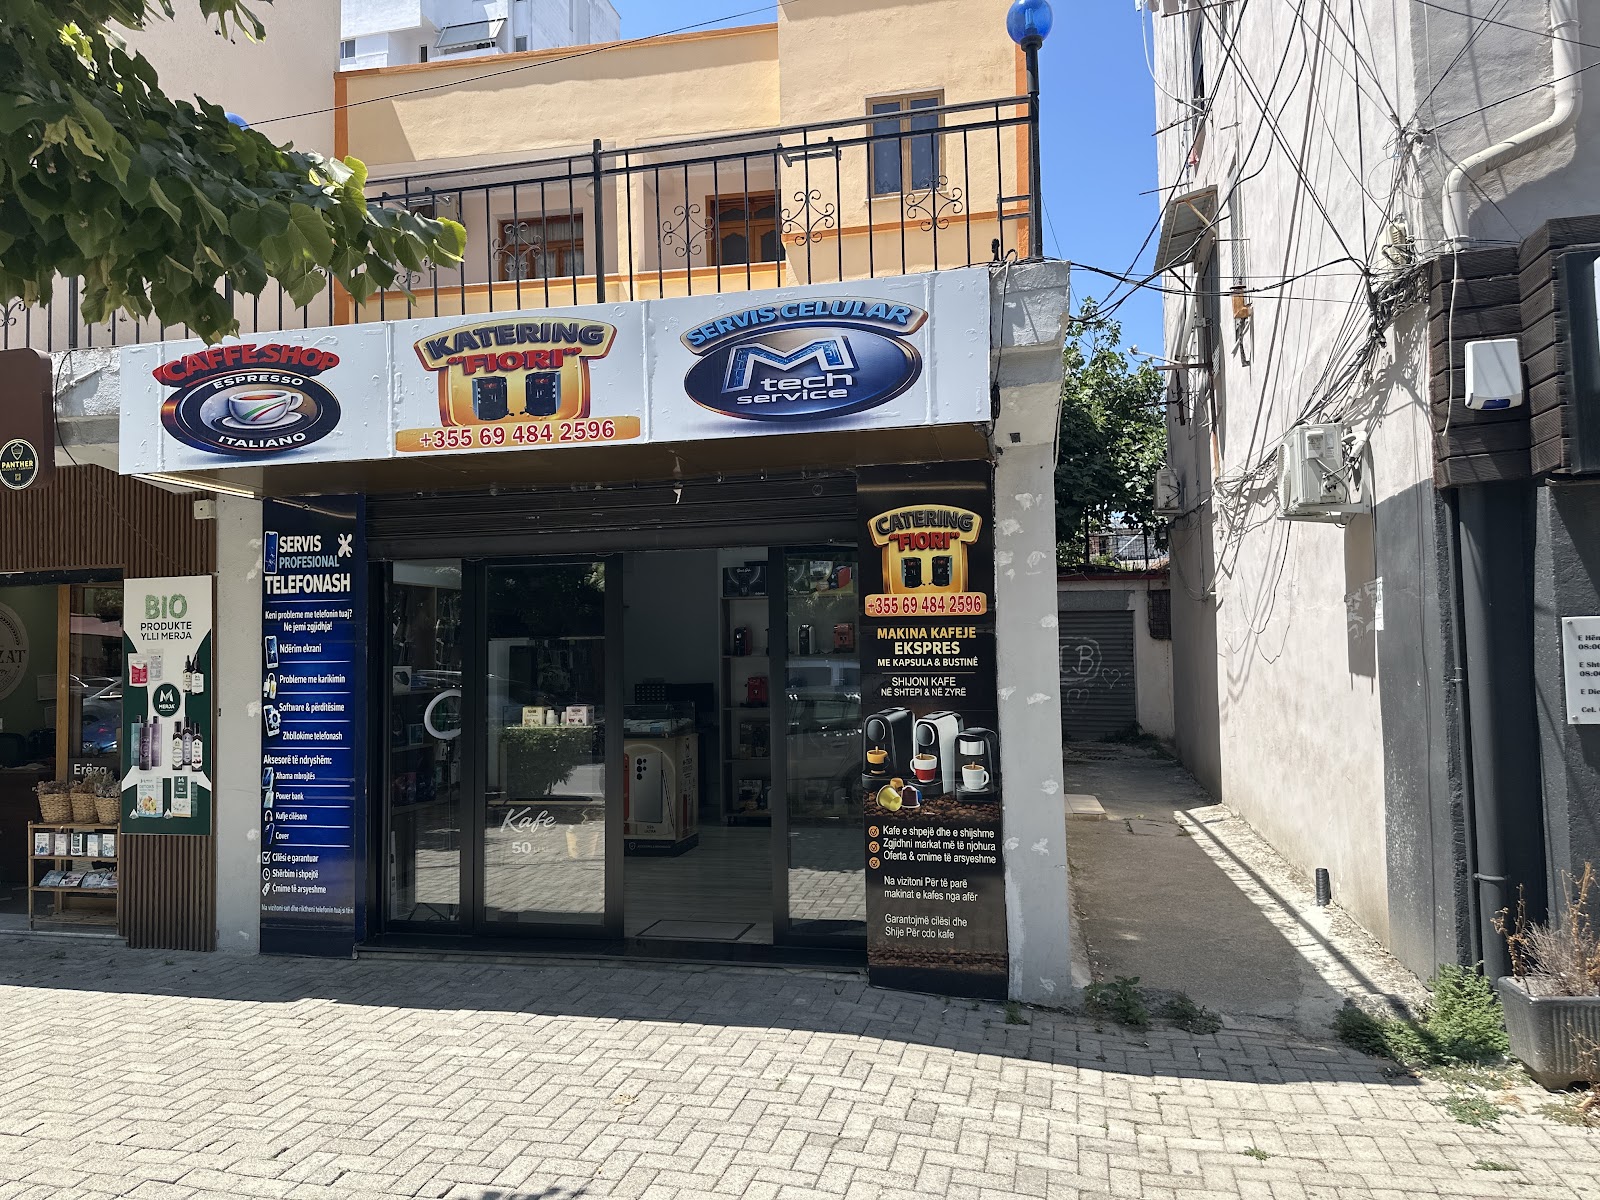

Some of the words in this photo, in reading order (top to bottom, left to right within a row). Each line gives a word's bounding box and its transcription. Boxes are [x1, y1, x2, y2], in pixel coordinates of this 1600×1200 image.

[686, 306, 777, 347] SERVIS
[781, 299, 911, 325] CELULAR
[424, 322, 605, 360] KATERING
[153, 343, 257, 384] CAFFE
[254, 343, 340, 372] SHOP
[213, 374, 304, 390] ESPRESSO
[761, 372, 852, 392] tech
[736, 388, 848, 405] service
[218, 432, 306, 448] ITALIANO
[420, 428, 472, 449] +355
[479, 426, 505, 446] 69
[512, 423, 552, 444] 484
[560, 419, 615, 442] 2596
[1, 460, 34, 469] PANTHER
[876, 509, 974, 534] CATERING
[279, 535, 322, 553] SERVIS
[279, 555, 340, 569] PROFESIONAL
[265, 573, 351, 594] TELEFONASH
[144, 594, 188, 619] BIO
[868, 597, 898, 614] +355
[902, 596, 918, 614] 69
[921, 596, 946, 613] 484
[949, 595, 981, 613] 2596
[265, 610, 278, 620] Keni
[278, 610, 304, 621] probleme
[314, 610, 338, 618] telefonin
[140, 622, 192, 631] PRODUKTE
[284, 622, 292, 631] Ne
[292, 622, 306, 633] jemi
[877, 628, 928, 640] MAKINA
[930, 626, 976, 638] KAFEJE
[140, 632, 159, 641] YLLI
[161, 632, 192, 640] MERJA
[280, 644, 302, 653] Ndërim
[302, 643, 322, 653] ekrani
[894, 641, 960, 655] EKSPRES
[878, 658, 890, 666] ME
[893, 658, 932, 666] KAPSULA
[934, 658, 941, 666] &
[280, 674, 307, 684] Probleme
[318, 674, 346, 684] karikimin
[892, 676, 928, 686] SHIJONI
[931, 676, 956, 686] KAFE
[881, 687, 892, 696] NË
[924, 688, 930, 696] &
[932, 687, 944, 696] NË
[944, 687, 966, 696] ZYRË
[279, 702, 304, 712] Software
[305, 702, 310, 712] &
[314, 731, 342, 740] telefonash
[263, 754, 292, 764] Aksesorë
[292, 755, 298, 764] të
[276, 792, 291, 800] Power
[292, 792, 304, 800] bank
[500, 807, 556, 833] Kafe
[276, 832, 290, 840] Cover
[882, 825, 900, 836] Kafe
[902, 827, 908, 836] e
[936, 827, 951, 837] dhe
[952, 828, 958, 838] e
[960, 828, 995, 838] shijshme
[511, 842, 532, 854] 50
[882, 838, 912, 850] Zgjidhni
[914, 839, 942, 849] markat
[942, 840, 955, 850] më
[956, 840, 964, 850] të
[966, 841, 996, 852] njohura
[292, 854, 319, 864] garantuar
[884, 850, 907, 860] Oferta
[908, 851, 915, 860] &
[944, 854, 952, 862] të
[954, 854, 996, 865] arsyeshme
[884, 876, 896, 886] Na
[896, 876, 923, 886] vizitoni
[925, 877, 938, 887] Për
[940, 878, 948, 888] të
[950, 879, 968, 890] parë
[884, 889, 914, 899] makinat
[922, 890, 944, 900] kafes
[946, 892, 960, 902] nga
[962, 892, 978, 902] afër
[884, 914, 930, 926] Garantojmë
[931, 916, 951, 926] cilësi
[952, 917, 968, 926] dhe
[885, 926, 904, 938] Shije
[906, 928, 920, 938] Për
[938, 929, 954, 939] kafe
